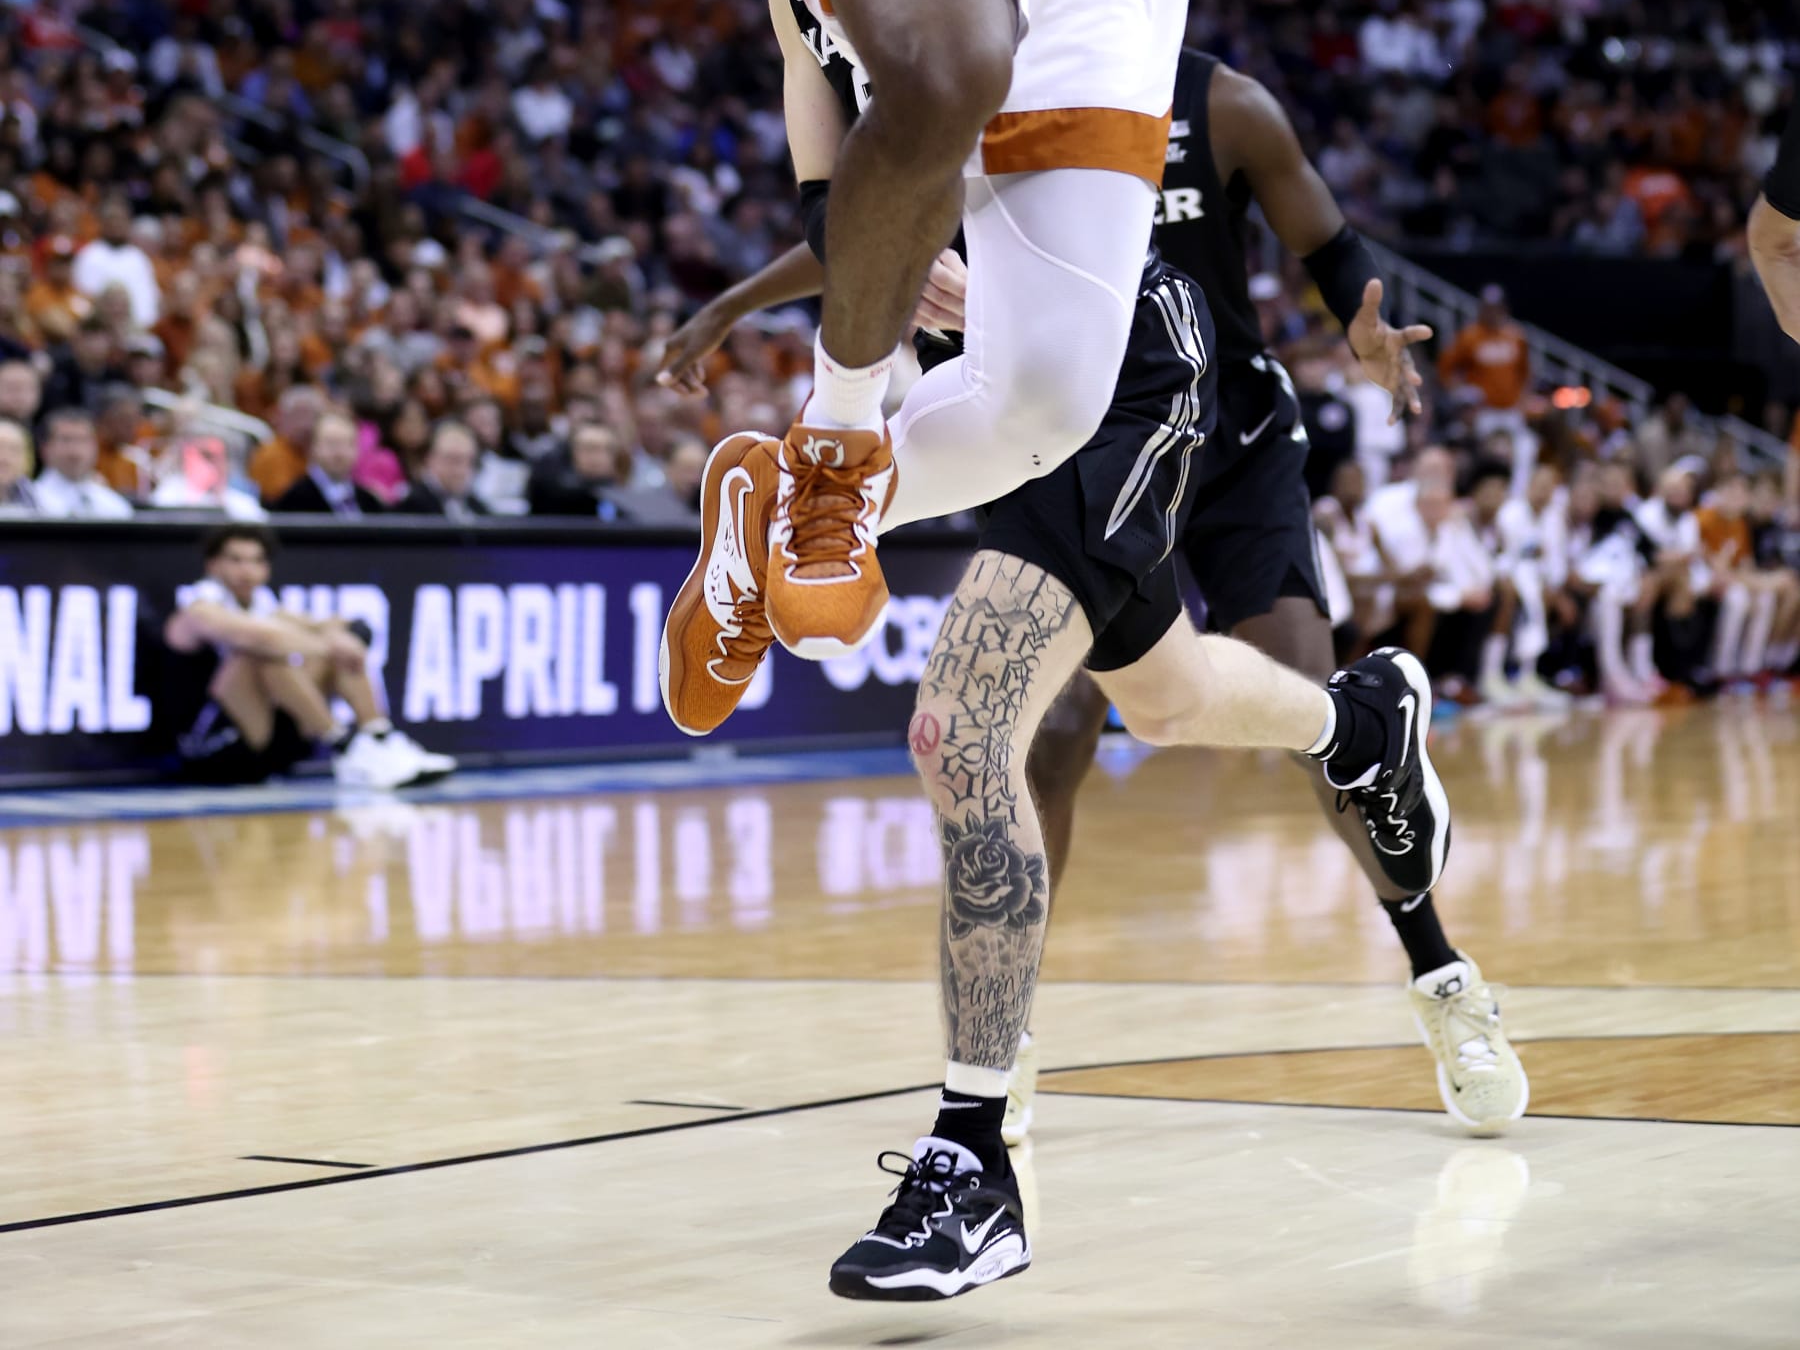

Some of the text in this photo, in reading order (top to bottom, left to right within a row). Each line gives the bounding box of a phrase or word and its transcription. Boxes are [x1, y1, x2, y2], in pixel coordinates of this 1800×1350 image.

[0, 584, 153, 735] NAL
[402, 583, 618, 721] APRIL
[868, 594, 955, 686] CB
